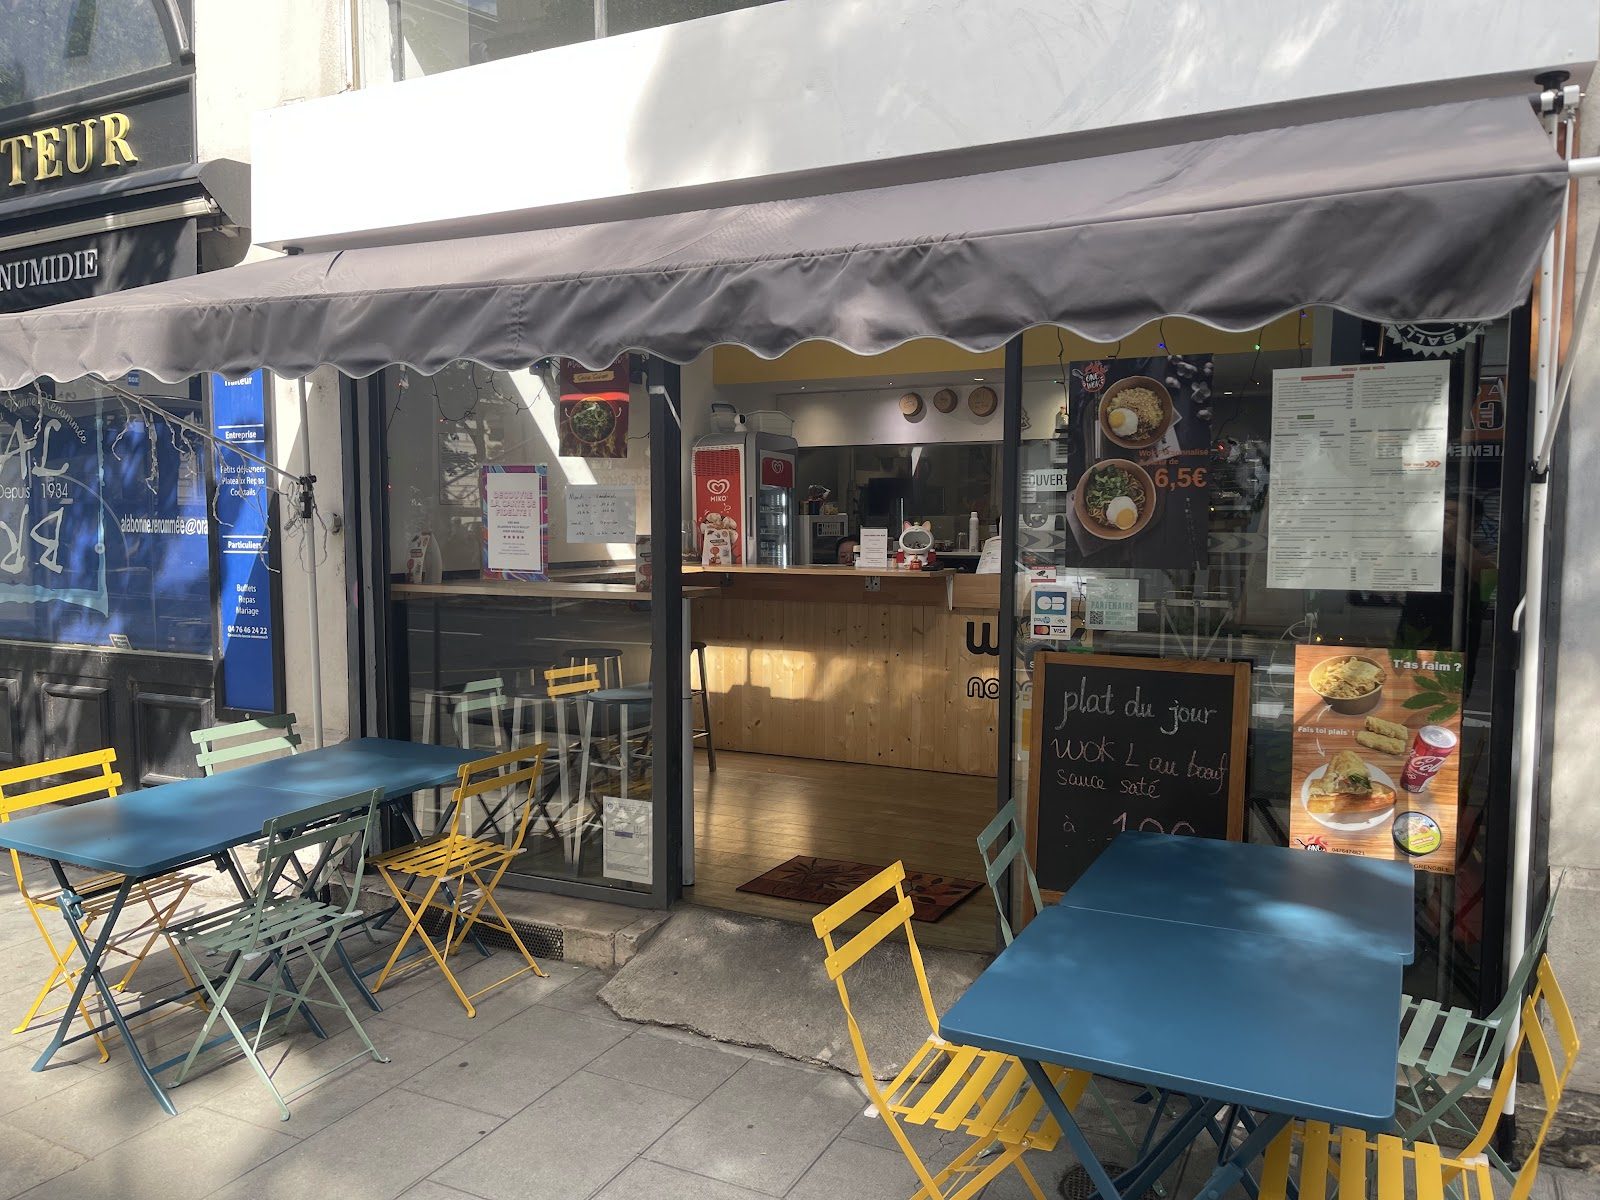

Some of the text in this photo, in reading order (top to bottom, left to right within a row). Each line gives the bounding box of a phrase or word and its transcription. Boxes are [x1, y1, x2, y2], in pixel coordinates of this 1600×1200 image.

[0, 112, 139, 187] TEUR
[0, 248, 98, 292] NUMIDIE
[225, 430, 256, 440] Entreprise
[1155, 467, 1207, 491] 6,5€
[41, 482, 69, 499] 1934
[228, 541, 262, 549] Particuliers
[238, 595, 256, 605] Repas
[235, 606, 259, 617] Mariage
[1421, 661, 1451, 671] faim
[1054, 676, 1217, 735] plat du jour
[1148, 757, 1178, 777] au
[1413, 863, 1450, 872] GRENOBLE
